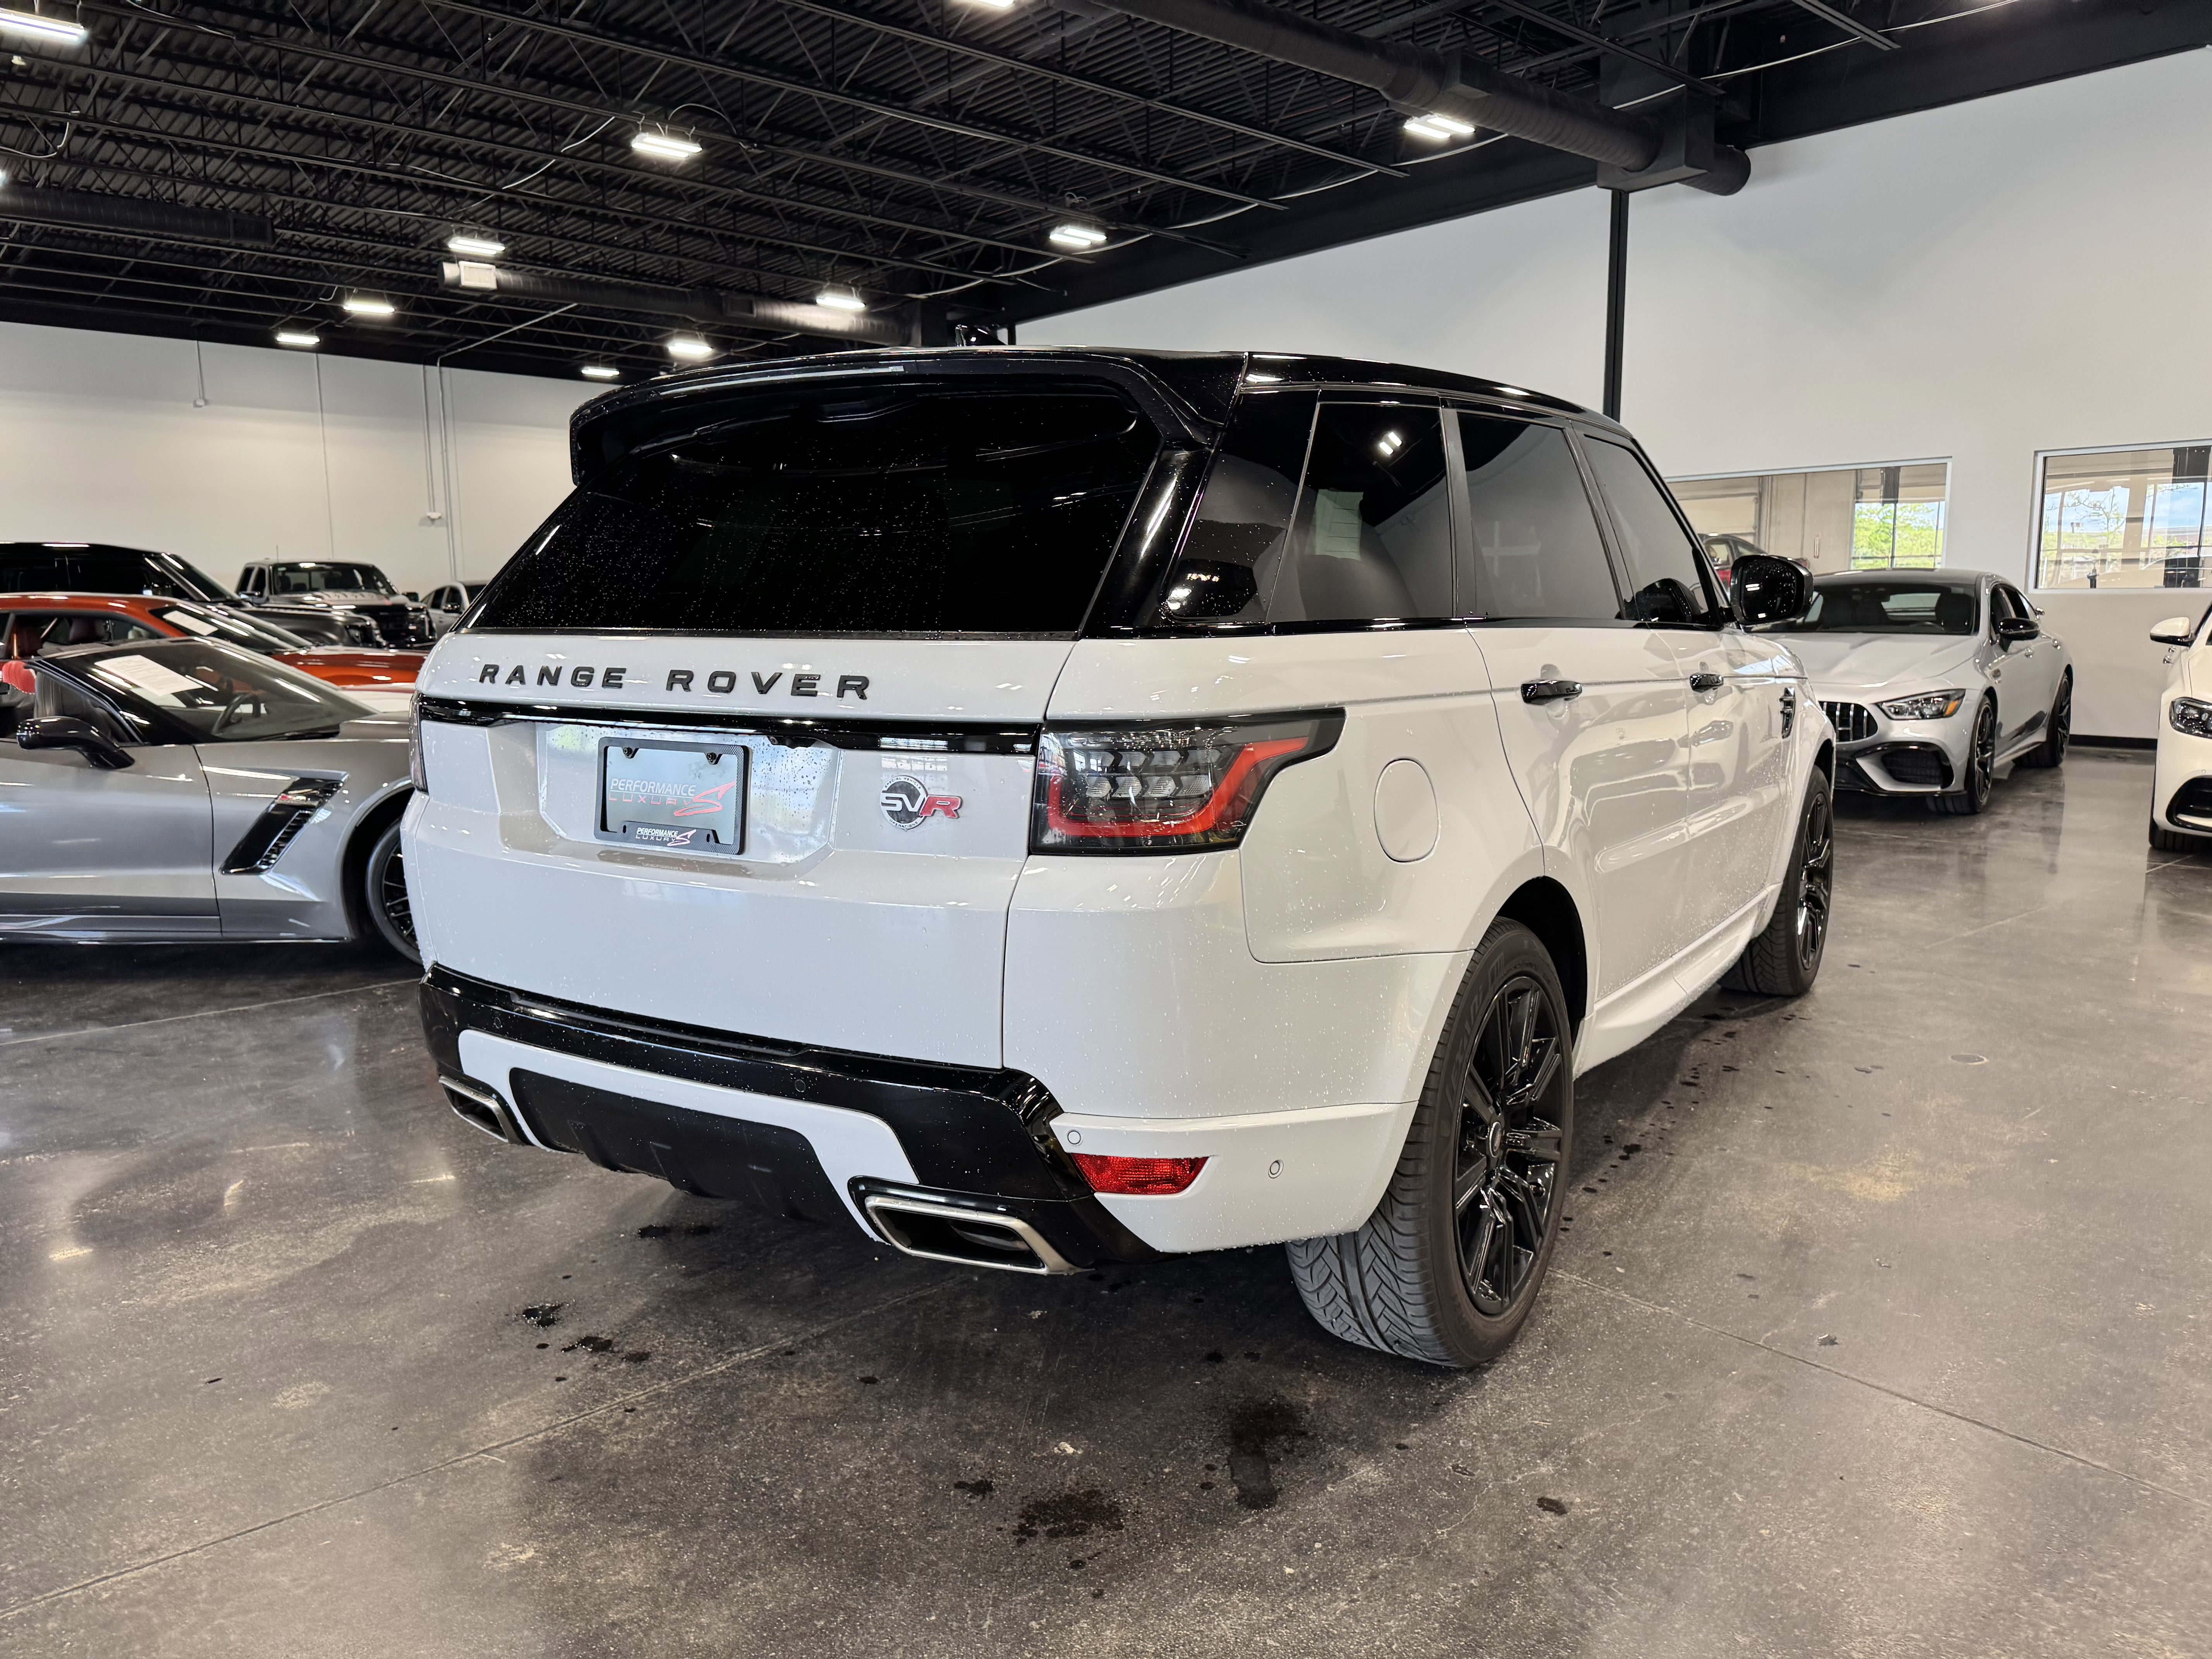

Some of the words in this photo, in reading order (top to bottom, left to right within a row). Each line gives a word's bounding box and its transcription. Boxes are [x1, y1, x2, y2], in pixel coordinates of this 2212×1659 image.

[479, 664, 627, 689] RANGE
[665, 670, 870, 700] ROVER
[610, 778, 697, 797] PERFORMANCE
[884, 777, 902, 788] SPECIAL
[904, 777, 921, 790] VEHICLE
[879, 792, 963, 819] SVR
[889, 819, 918, 828] OPERATIONS
[636, 827, 678, 837] PERFORMANCE
